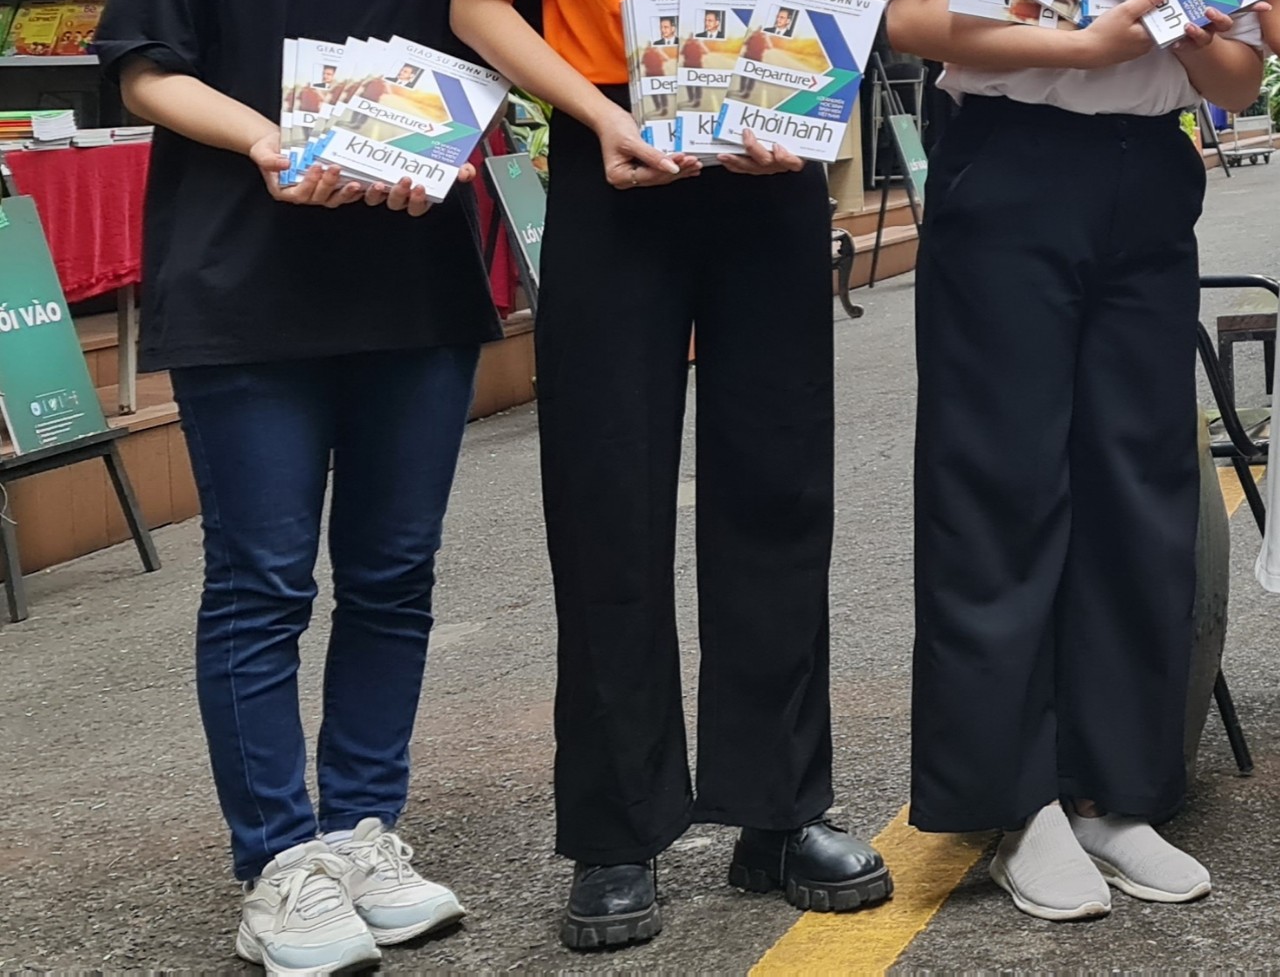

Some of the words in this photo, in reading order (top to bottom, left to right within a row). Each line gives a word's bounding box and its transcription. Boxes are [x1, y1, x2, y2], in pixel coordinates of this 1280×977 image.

[856, 0, 871, 9] VU
[452, 61, 483, 77] JOHN
[485, 72, 501, 82] VU
[687, 70, 731, 86] Depar
[743, 60, 812, 88] Departure
[357, 99, 429, 131] Departure
[782, 114, 834, 144] hành
[392, 149, 446, 183] hành
[0, 303, 18, 332] ỐI
[18, 299, 62, 326] VÀO
